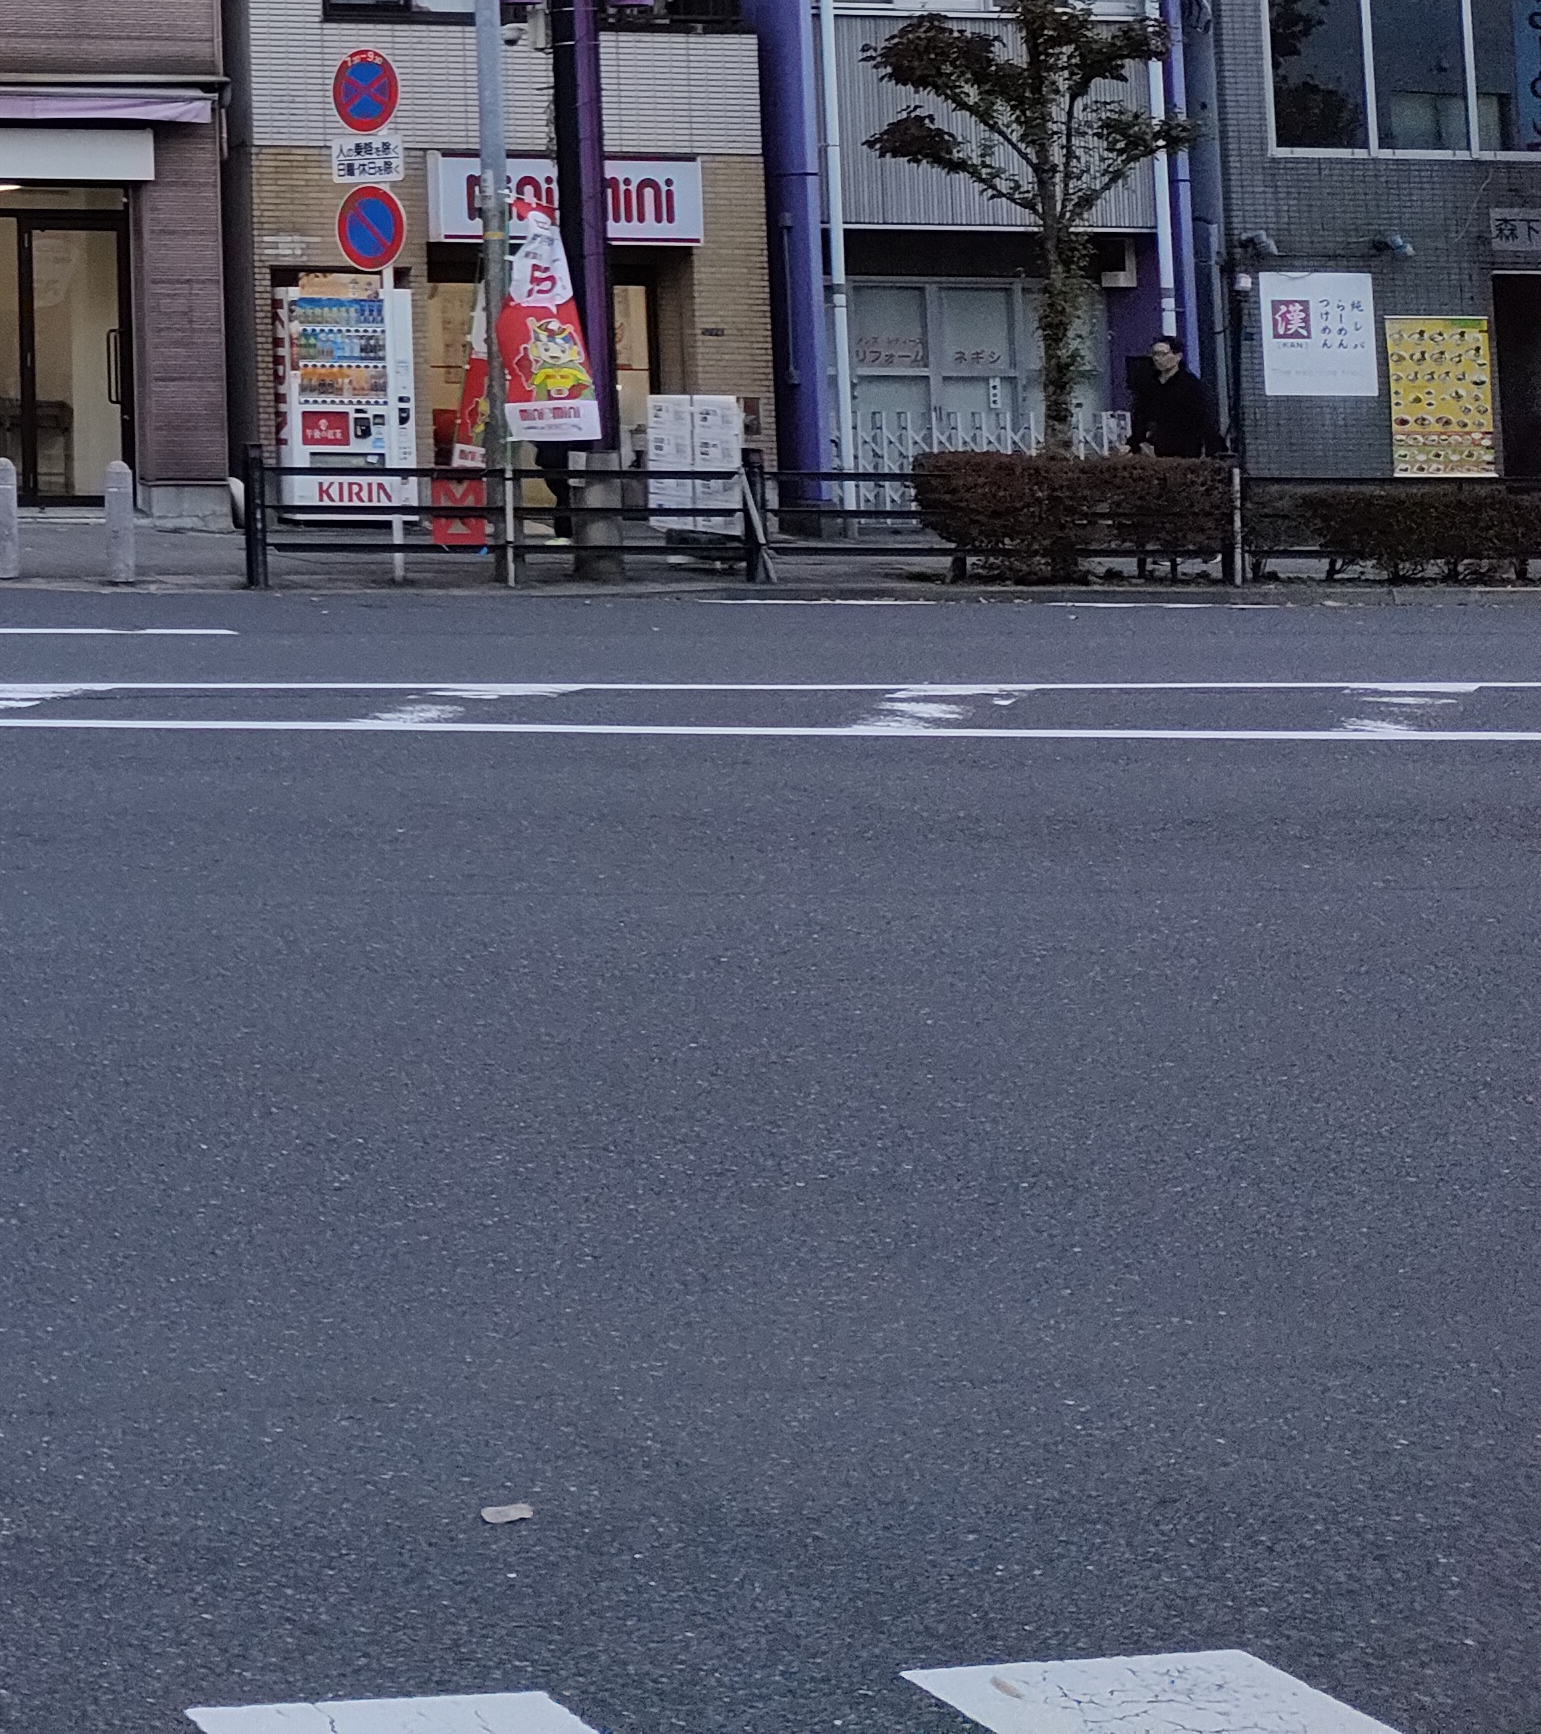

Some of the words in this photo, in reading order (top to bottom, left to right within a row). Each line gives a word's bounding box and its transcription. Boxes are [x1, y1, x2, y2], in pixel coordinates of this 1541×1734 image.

[1274, 302, 1310, 337] 漢
[1318, 298, 1333, 349] つけめん
[1336, 299, 1349, 350] らーめん
[855, 349, 923, 365] リフォーム
[954, 349, 1002, 365] ネギシ
